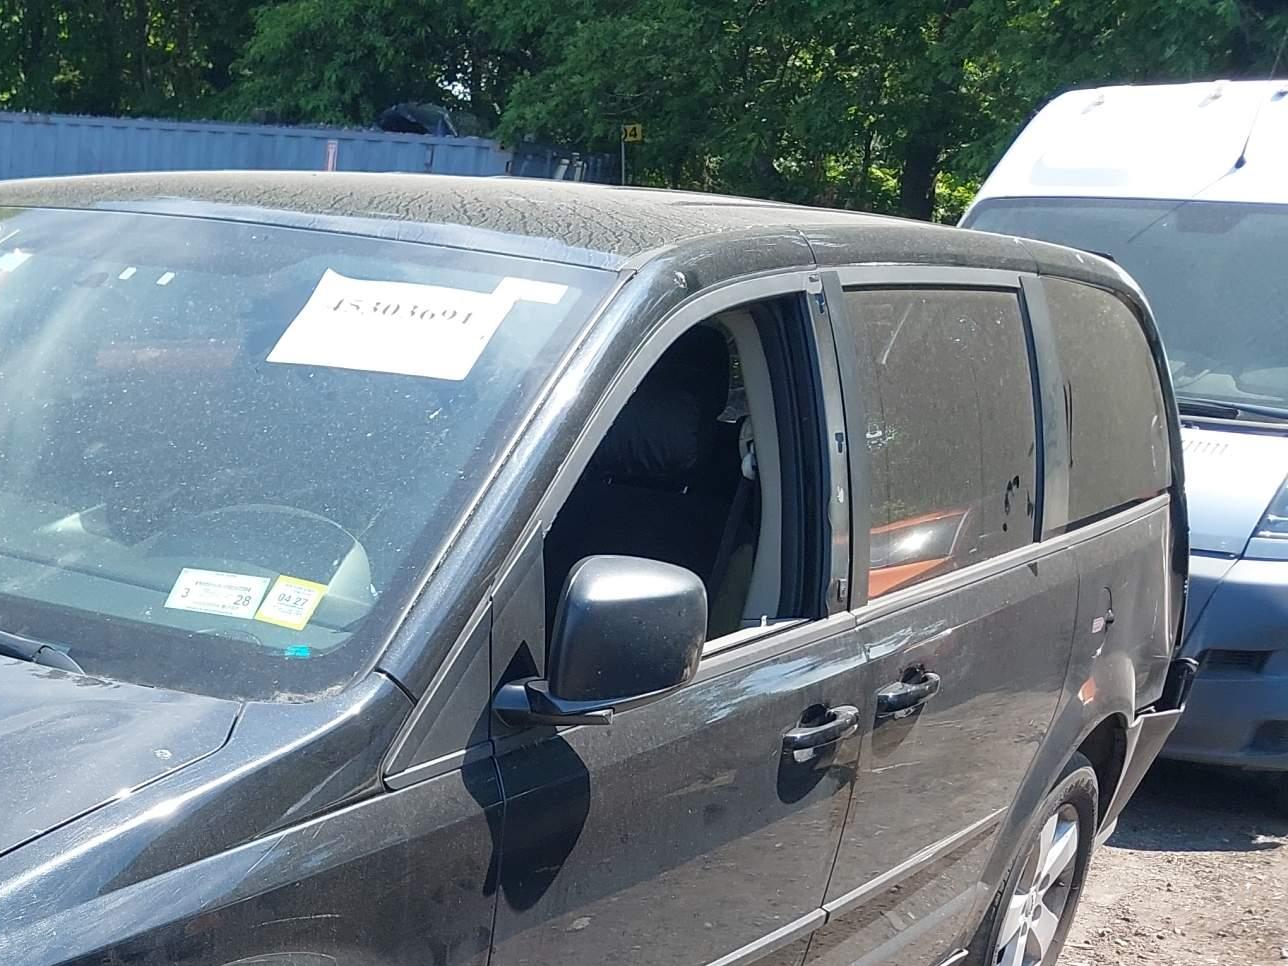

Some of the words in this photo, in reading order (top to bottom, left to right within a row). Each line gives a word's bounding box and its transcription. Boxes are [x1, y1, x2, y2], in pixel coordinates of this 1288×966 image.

[180, 587, 191, 599] 3
[232, 594, 253, 608] 28
[294, 596, 309, 607] 27
